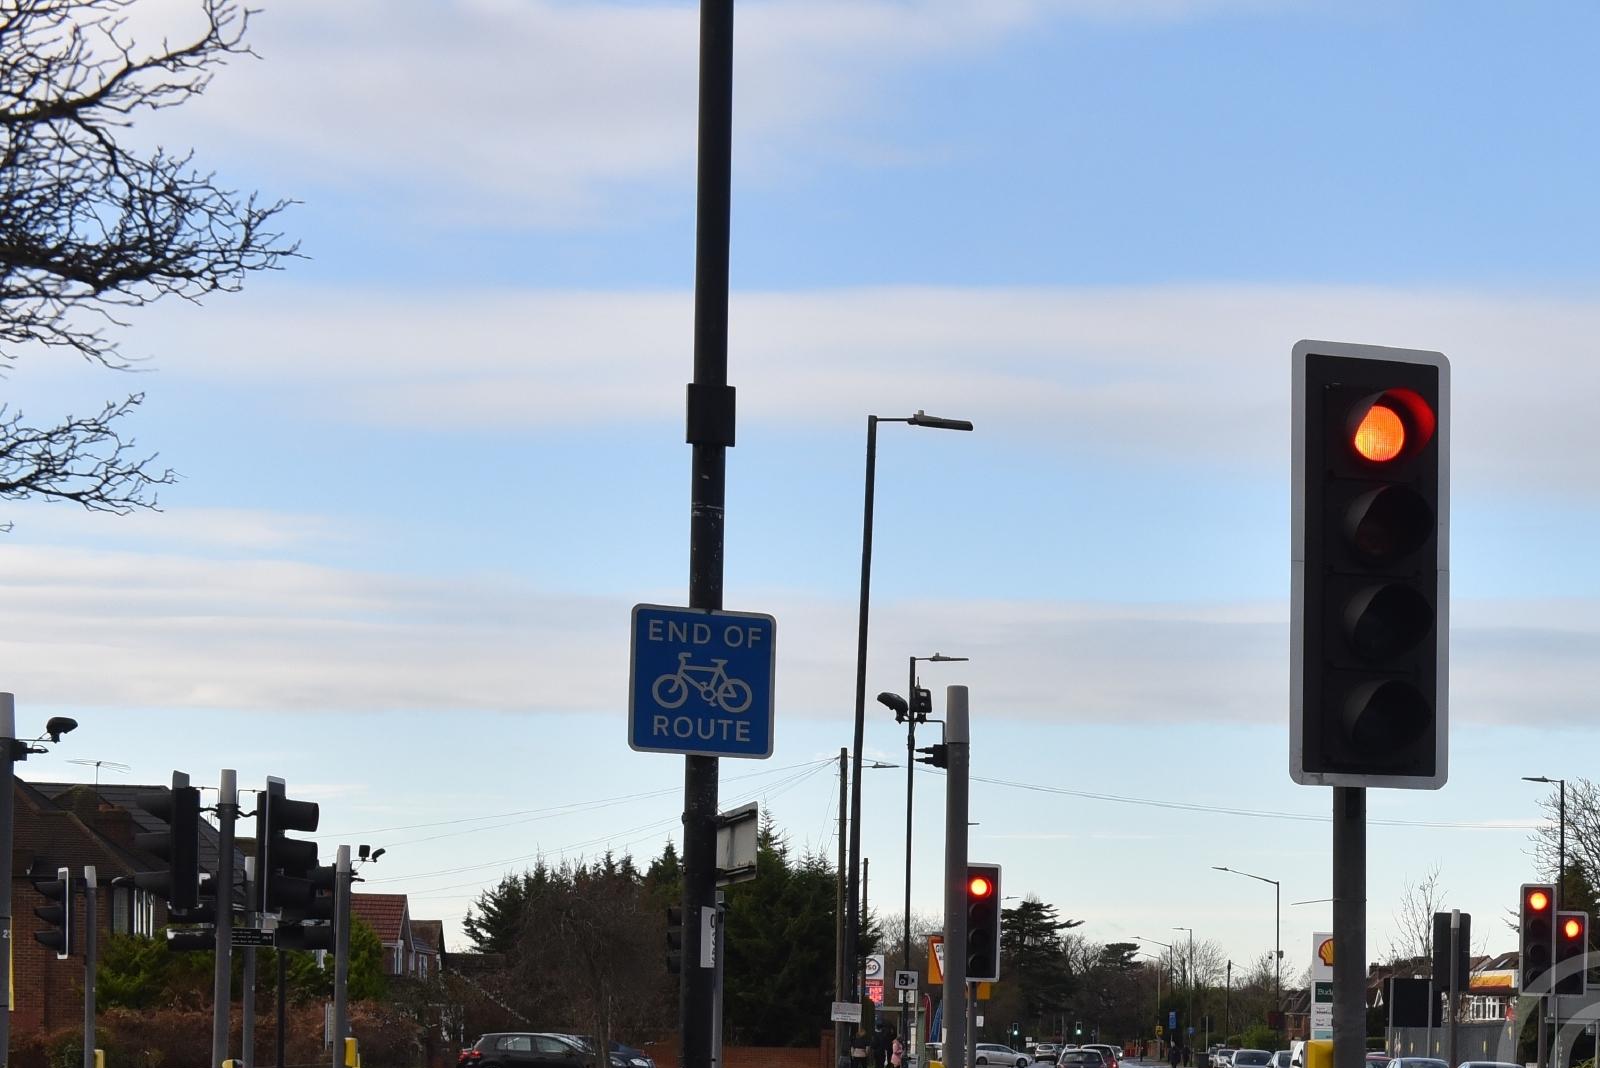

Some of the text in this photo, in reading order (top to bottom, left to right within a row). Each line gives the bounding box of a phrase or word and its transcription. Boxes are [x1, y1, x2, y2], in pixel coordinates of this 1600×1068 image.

[648, 619, 762, 649] END OF
[652, 715, 751, 742] ROUTE
